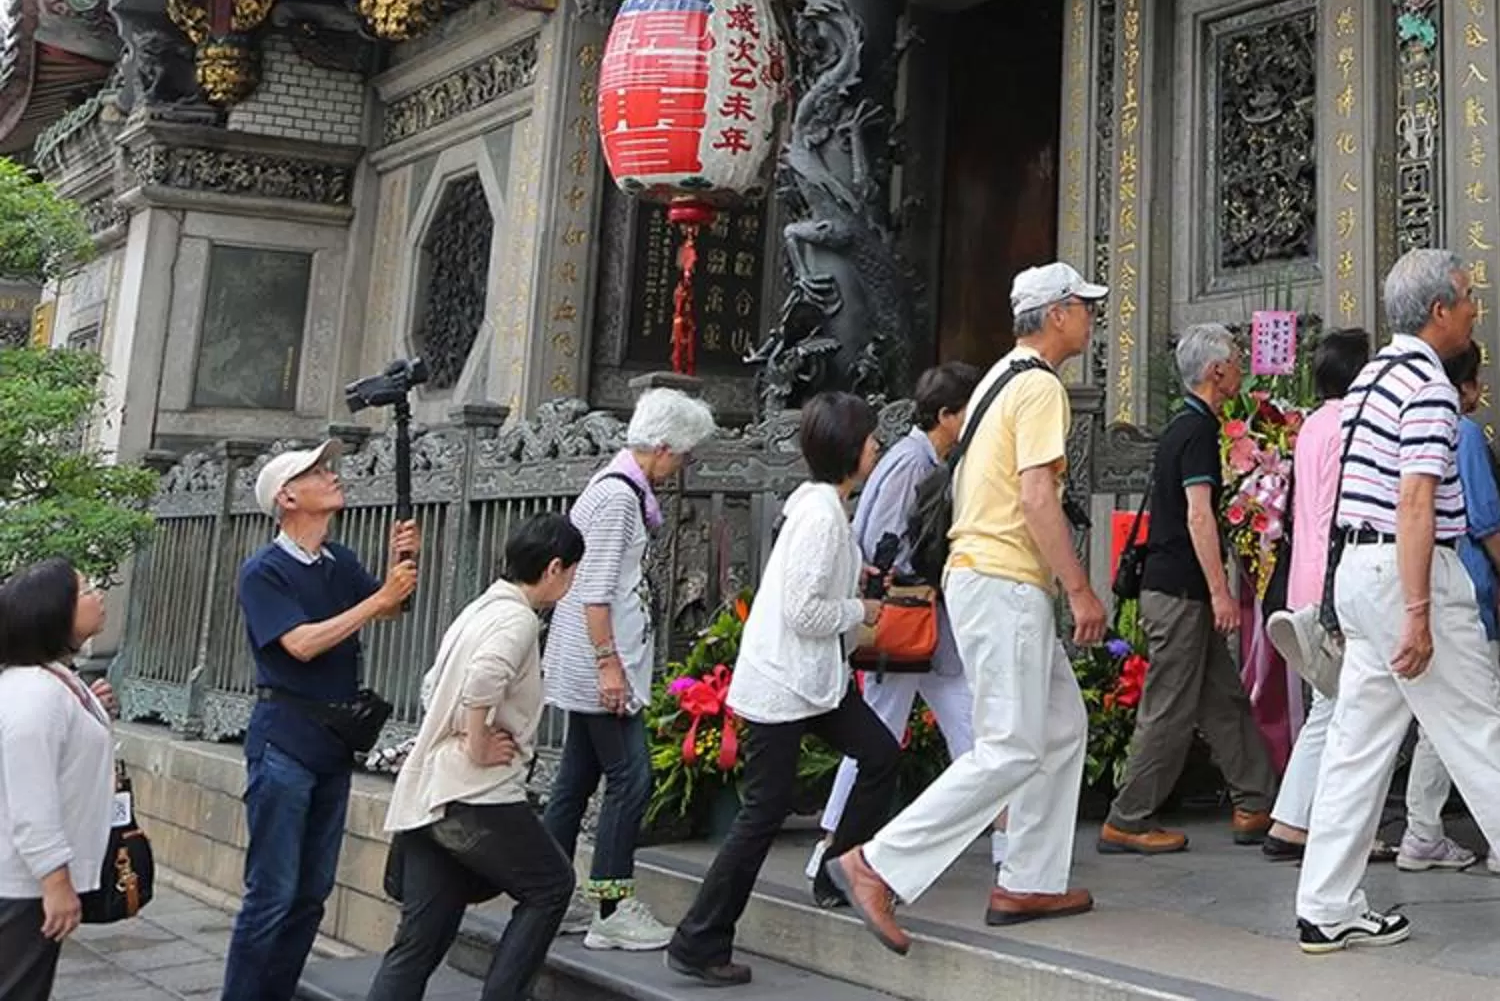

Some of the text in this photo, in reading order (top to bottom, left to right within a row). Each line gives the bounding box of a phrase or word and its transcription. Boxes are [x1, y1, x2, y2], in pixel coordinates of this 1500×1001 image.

[713, 2, 760, 156] 歲次乙未年
